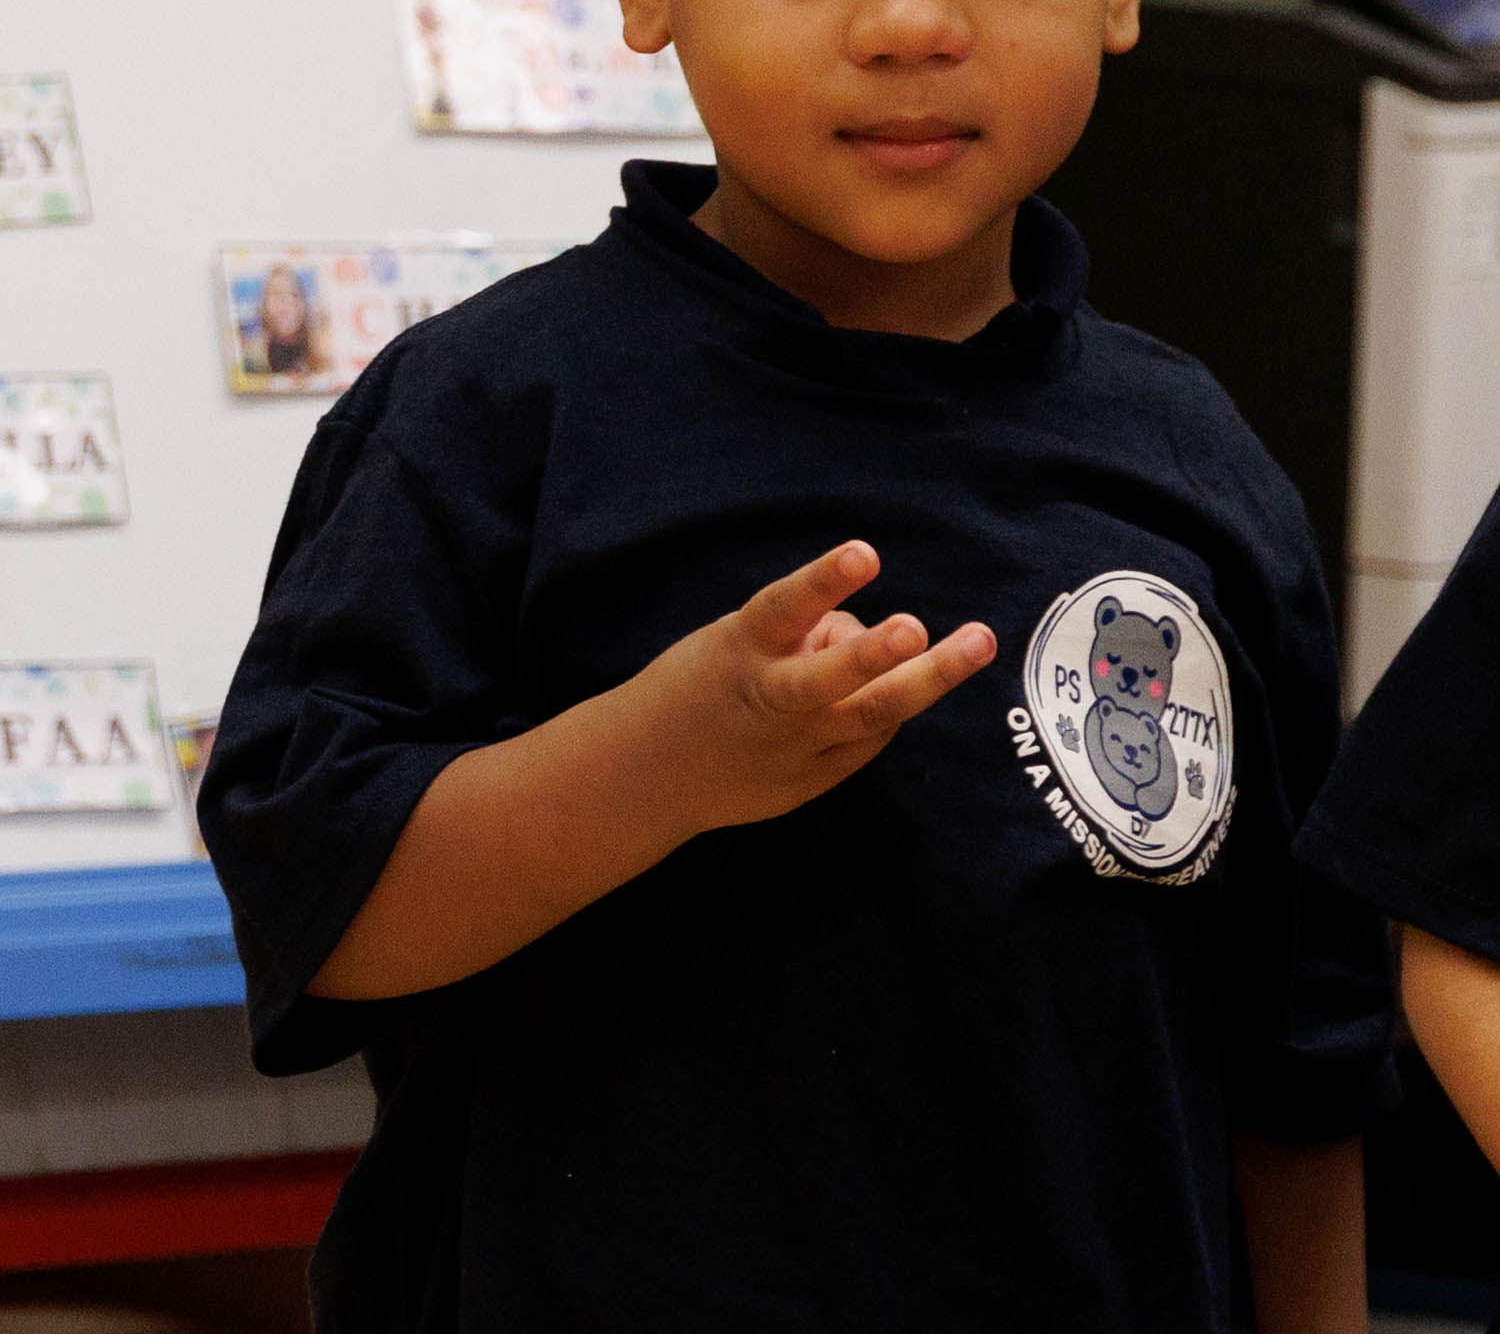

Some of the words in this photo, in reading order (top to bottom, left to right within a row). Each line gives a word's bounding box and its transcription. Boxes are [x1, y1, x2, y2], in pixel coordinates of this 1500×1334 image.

[1055, 664, 1081, 704] PS
[1166, 701, 1218, 751] 277X
[1006, 706, 1041, 759] ON
[1024, 763, 1052, 789] A
[1044, 785, 1124, 877] MISSION
[1158, 784, 1238, 887] REATN
